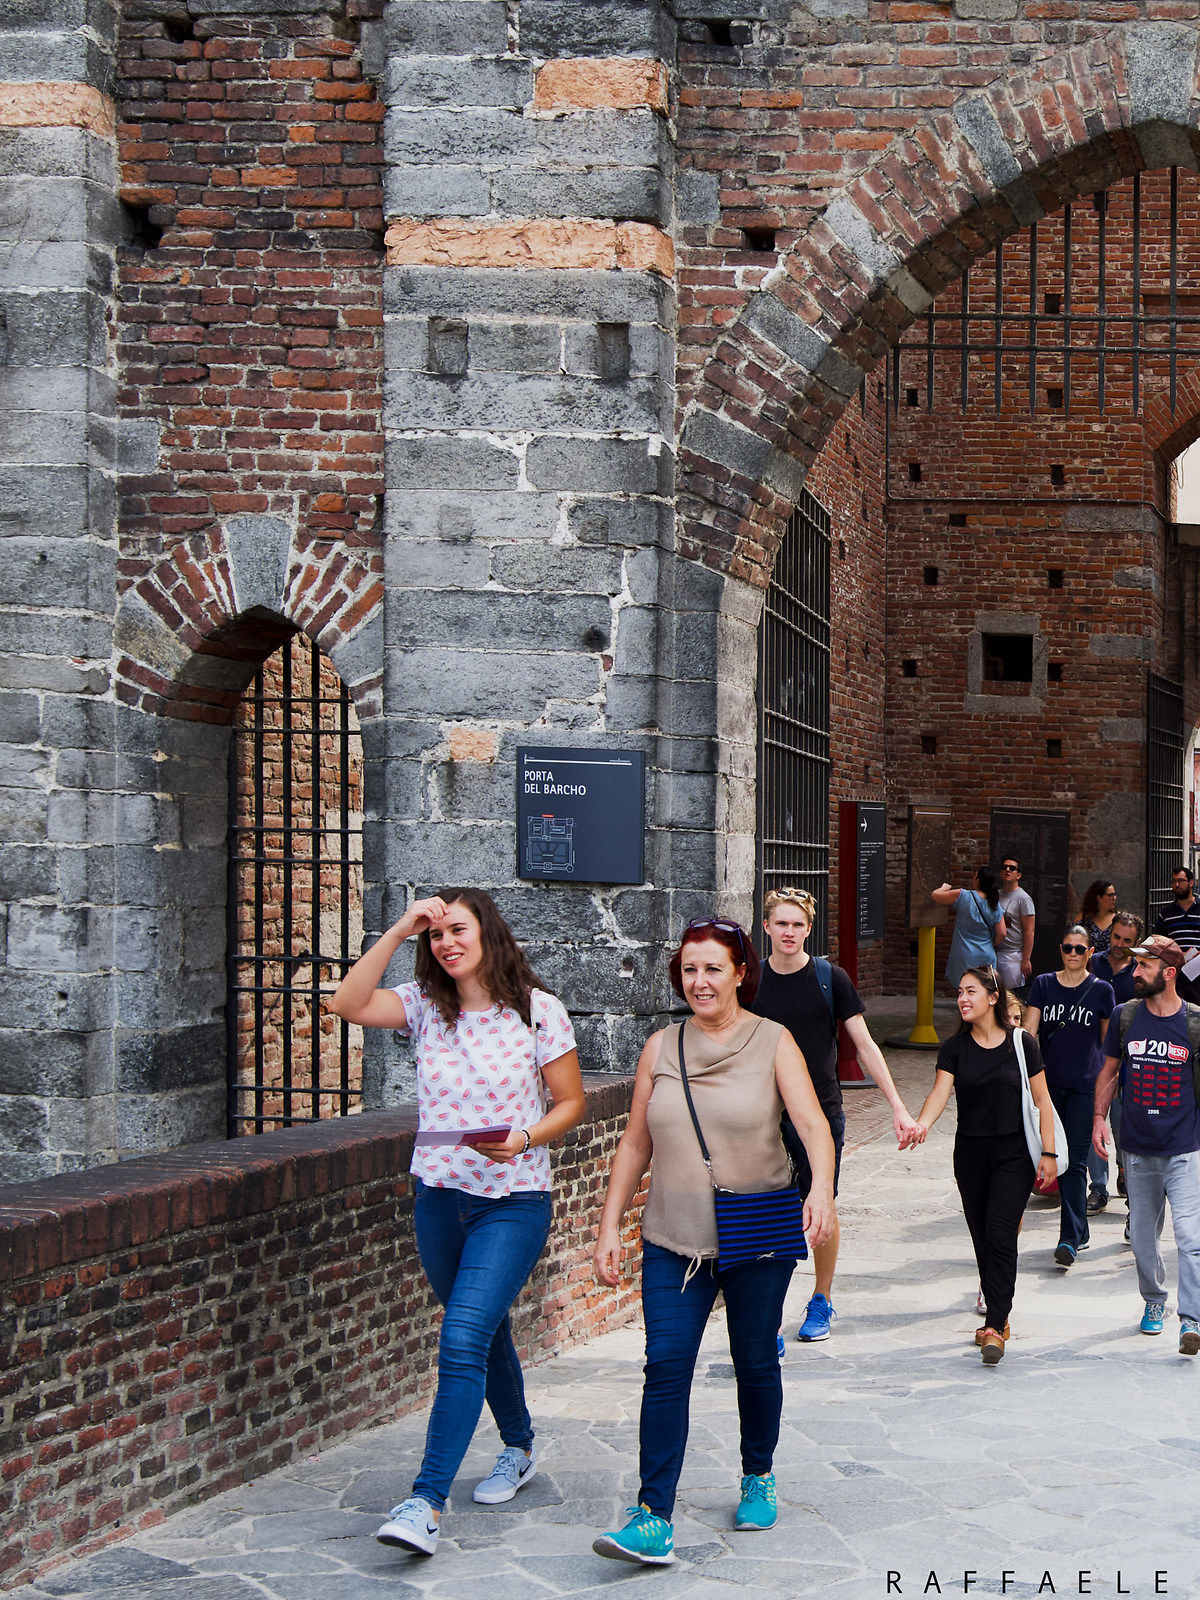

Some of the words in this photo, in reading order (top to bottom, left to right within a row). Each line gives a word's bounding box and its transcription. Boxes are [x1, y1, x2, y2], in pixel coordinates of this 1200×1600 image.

[524, 770, 554, 782] PORTA
[524, 783, 541, 794] DEL
[543, 784, 587, 796] BARCHO
[1043, 1003, 1065, 1022] GAP
[1068, 1005, 1093, 1027] NYC
[1147, 1040, 1168, 1057] 20
